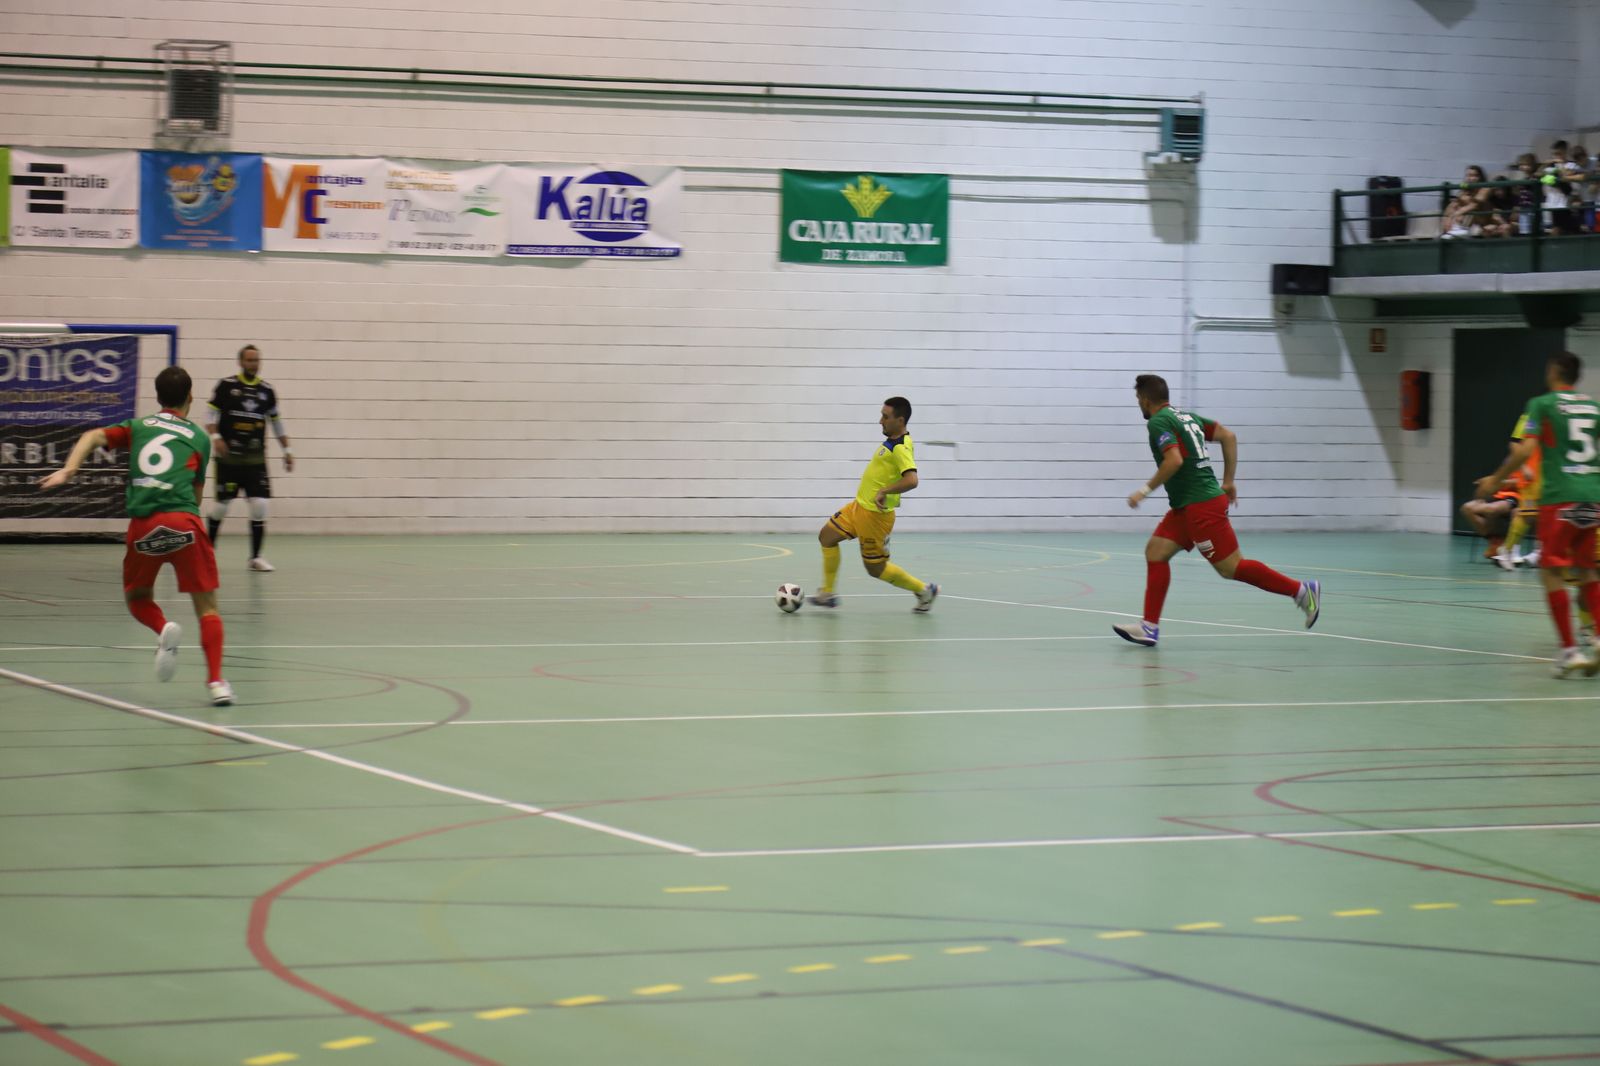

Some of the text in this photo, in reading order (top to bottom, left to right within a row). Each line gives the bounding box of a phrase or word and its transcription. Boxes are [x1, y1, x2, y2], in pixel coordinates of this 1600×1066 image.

[536, 175, 649, 221] Kalúa
[31, 226, 66, 238] Santa
[821, 248, 907, 262] DE ZAMORA
[138, 433, 178, 476] 6
[1566, 419, 1597, 463] 5
